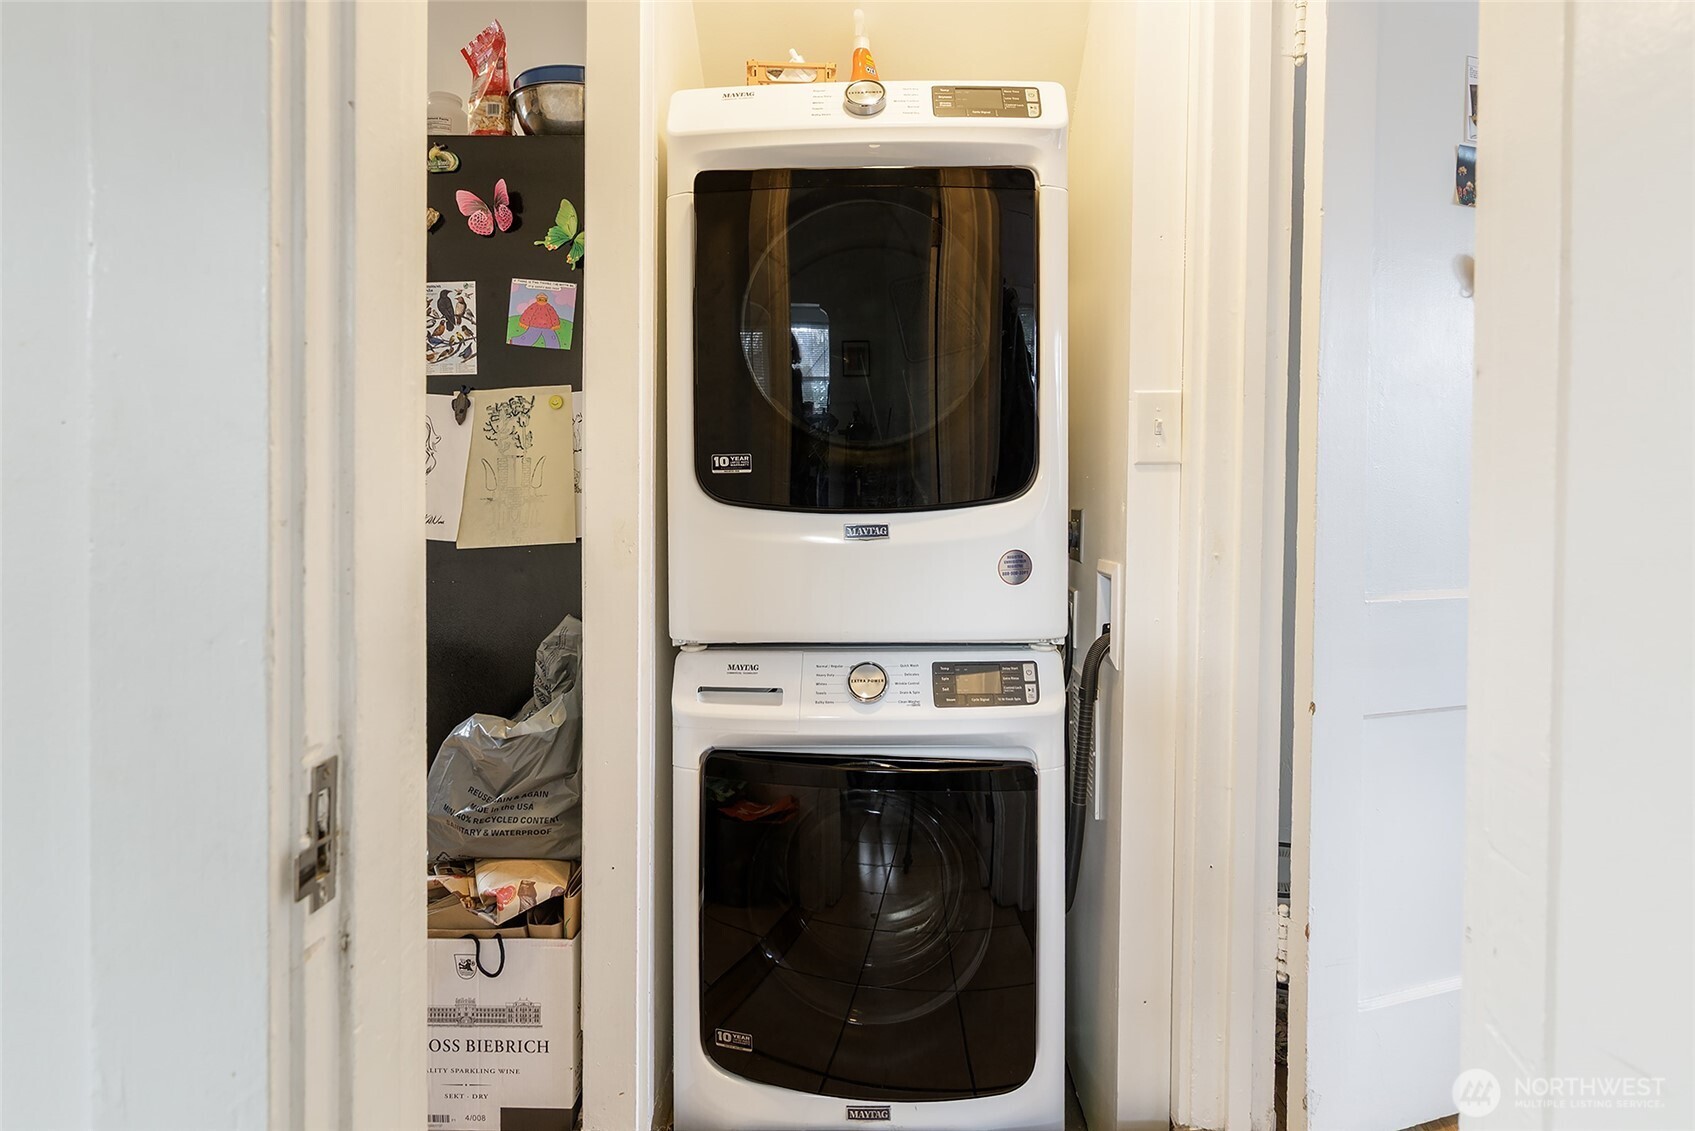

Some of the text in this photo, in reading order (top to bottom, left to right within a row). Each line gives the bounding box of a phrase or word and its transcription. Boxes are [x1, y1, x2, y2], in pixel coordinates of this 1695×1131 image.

[714, 456, 729, 467] 10
[846, 527, 887, 537] MAYTAG
[468, 786, 492, 803] REUSE
[521, 790, 549, 799] AGAIN
[517, 803, 534, 811] USA
[456, 812, 471, 824] 40%
[473, 816, 518, 824] RECYCLED
[521, 815, 560, 825] CONTENT
[483, 829, 489, 837] &
[491, 828, 552, 837] WATERPROOF
[718, 1031, 732, 1043] 10
[466, 1039, 550, 1054] BIEBRICH
[465, 1114, 486, 1122] 4/008
[849, 1110, 888, 1119] MAYTAG
